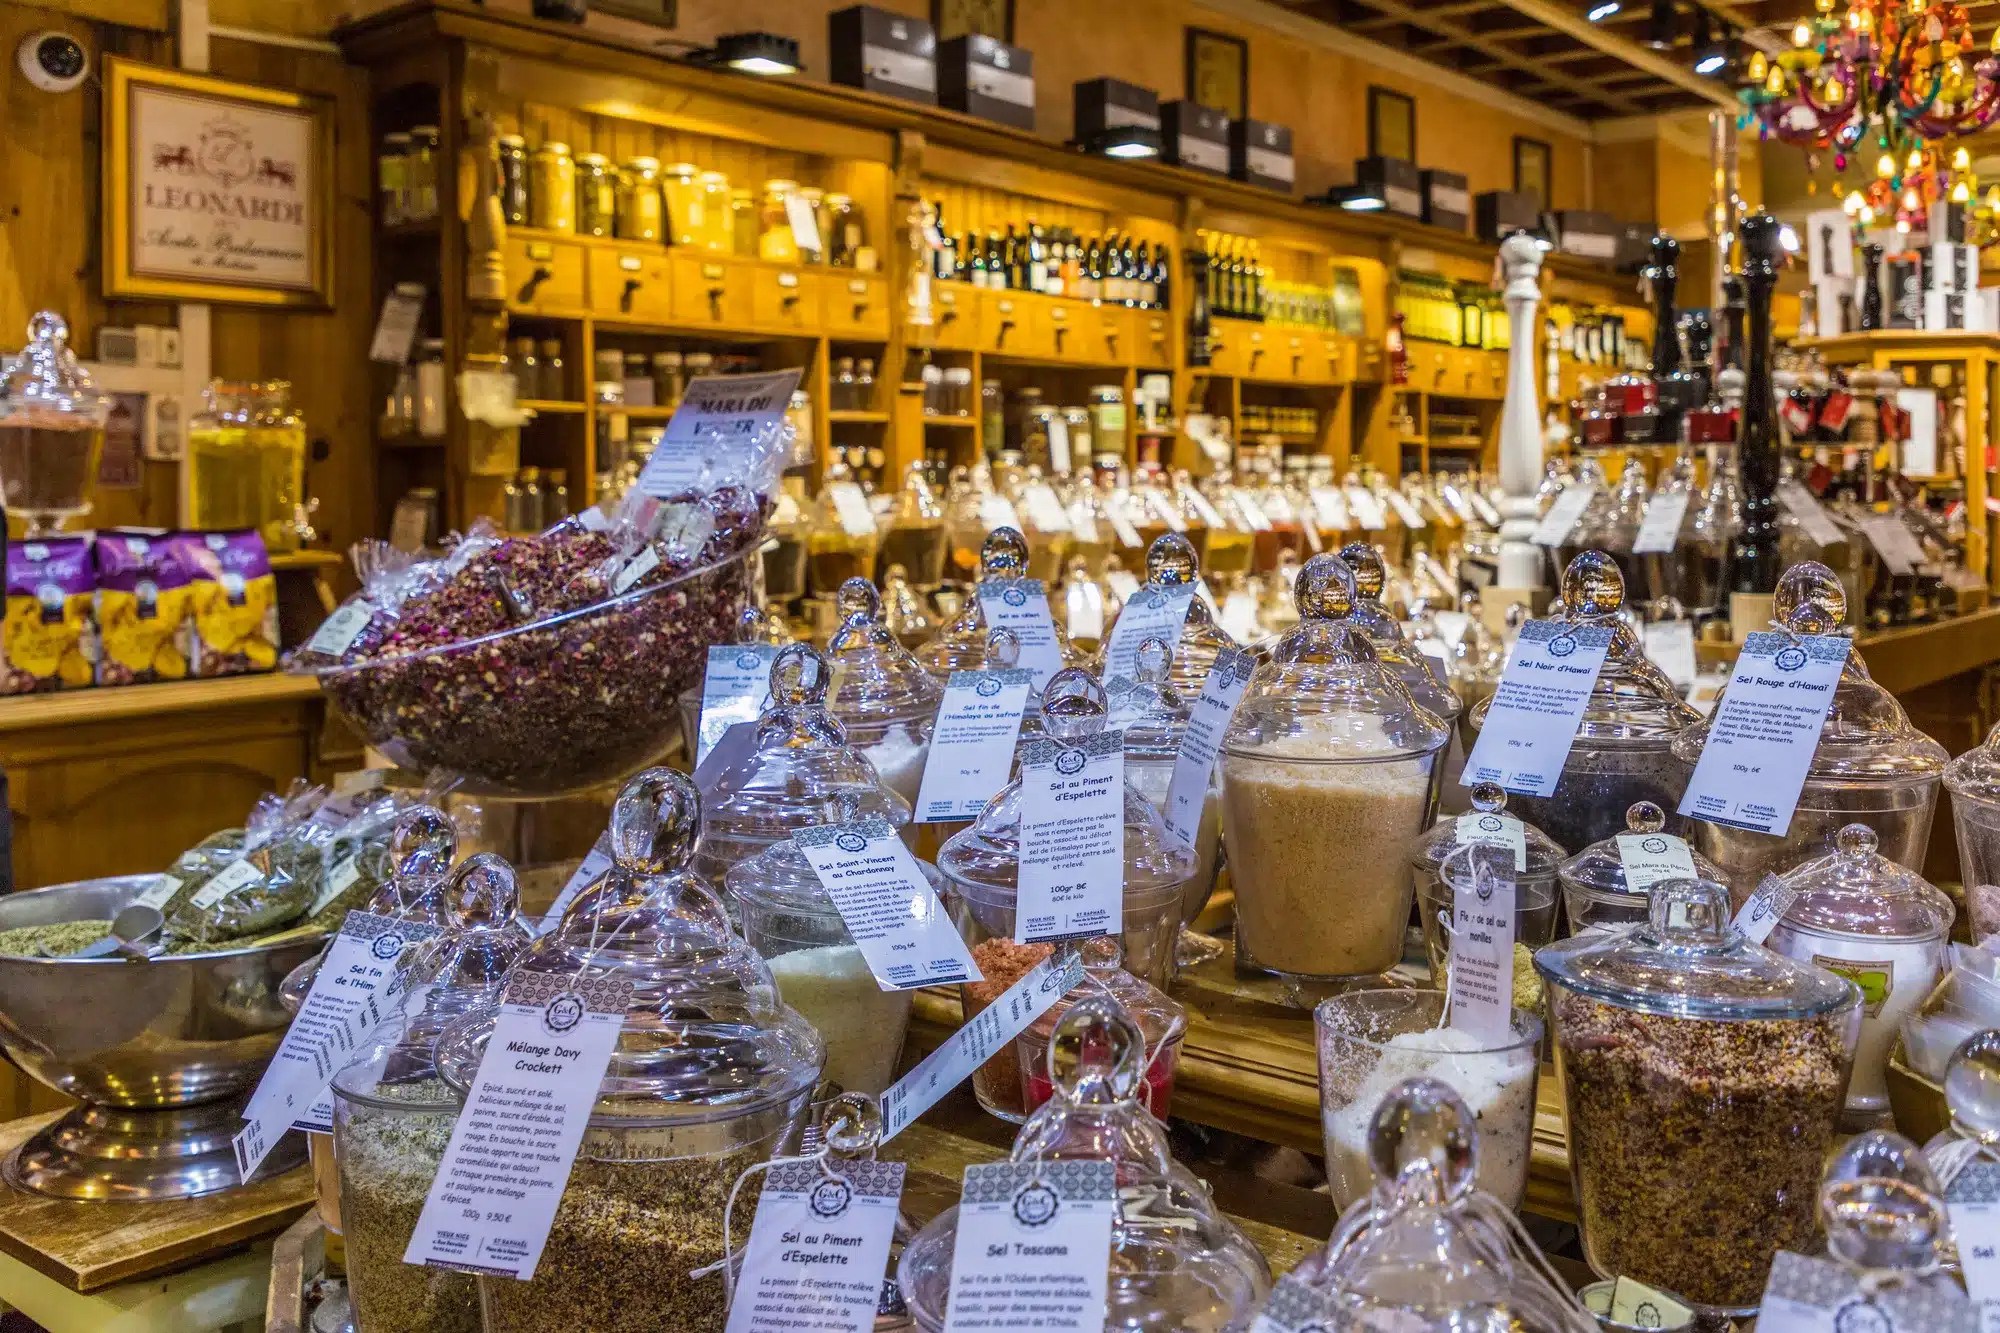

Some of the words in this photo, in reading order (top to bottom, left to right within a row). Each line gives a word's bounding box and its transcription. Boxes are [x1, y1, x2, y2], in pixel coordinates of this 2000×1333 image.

[146, 183, 304, 225] LEONARDI
[1518, 659, 1532, 668] Sel
[1535, 662, 1554, 671] Noir
[1558, 665, 1592, 675] d'Hawaï
[1737, 675, 1753, 684] Sel
[1755, 677, 1785, 688] Rouge
[1789, 680, 1829, 692] d'Hawaï
[1507, 739, 1521, 747] 100g
[1061, 755, 1080, 764] G&C
[1733, 763, 1748, 773] 100g
[1050, 782, 1064, 790] Sel
[1083, 775, 1113, 786] Piment
[1055, 789, 1107, 801] d'Espelette
[1033, 822, 1054, 830] piment
[1057, 817, 1094, 826] d'Espelette
[1051, 826, 1084, 836] n'emporte
[1027, 838, 1052, 846] bouche,
[1054, 835, 1078, 843] associé
[1090, 831, 1112, 839] délicat
[1051, 844, 1084, 853] l'Himalaya
[1085, 842, 1100, 850] pour
[819, 863, 833, 871] Sel
[837, 855, 896, 869] Saint-Vincent
[1023, 856, 1049, 865] mélange
[1051, 853, 1080, 861] équilibré
[1082, 849, 1100, 858] entre
[832, 871, 844, 879] au
[846, 866, 895, 878] Chardonnay
[1477, 914, 1484, 924] de
[1486, 915, 1494, 926] sel
[1496, 920, 1507, 928] aux
[1470, 932, 1492, 944] morilles
[350, 965, 366, 974] Sel
[370, 968, 382, 977] fin
[335, 976, 347, 985] de
[553, 1005, 576, 1016] G&C
[506, 1041, 551, 1058] Mélange
[554, 1048, 581, 1060] Davy
[515, 1060, 563, 1075] Crockett
[482, 1083, 503, 1095] Epicé,
[506, 1086, 527, 1096] sucré
[528, 1089, 536, 1097] et
[538, 1088, 553, 1098] salé.
[478, 1095, 511, 1107] Délicieux
[513, 1100, 542, 1112] mélange
[554, 1103, 567, 1113] sel,
[473, 1108, 498, 1119] poivre,
[500, 1112, 520, 1121] sucre
[522, 1113, 552, 1123] d'érable,
[554, 1115, 564, 1125] ail,
[469, 1120, 494, 1130] oignon,
[496, 1123, 533, 1136] coriandre,
[464, 1133, 487, 1144] rouge.
[489, 1135, 499, 1143] En
[501, 1135, 526, 1146] bouche
[528, 1139, 535, 1147] le
[536, 1141, 556, 1149] sucre
[460, 1143, 490, 1155] d'érable
[491, 1147, 519, 1159] apporte
[536, 1153, 561, 1164] touche
[455, 1156, 498, 1169] caramélisée
[500, 1161, 511, 1171] qui
[513, 1162, 540, 1173] adoucit
[451, 1169, 482, 1181] l'attaque
[484, 1172, 518, 1184] première
[519, 1177, 528, 1186] du
[529, 1179, 554, 1189] poivre,
[446, 1181, 454, 1189] et
[456, 1182, 485, 1193] souligne
[487, 1185, 495, 1193] le
[496, 1185, 526, 1200] mélange
[819, 1189, 843, 1200] G&C
[462, 1209, 480, 1220] 100g
[504, 1214, 512, 1223] €
[781, 1232, 800, 1243] Sel
[805, 1235, 818, 1244] au
[823, 1234, 863, 1247] Piment
[782, 1250, 848, 1265] d'Espelette
[987, 1243, 1008, 1258] Sel
[1014, 1244, 1068, 1256] Toscana
[772, 1279, 798, 1287] piment
[801, 1279, 846, 1290] d'Espelette
[848, 1284, 874, 1292] relève
[777, 1292, 816, 1301] n'emporte
[834, 1294, 842, 1302] la
[844, 1295, 876, 1306] bouche,
